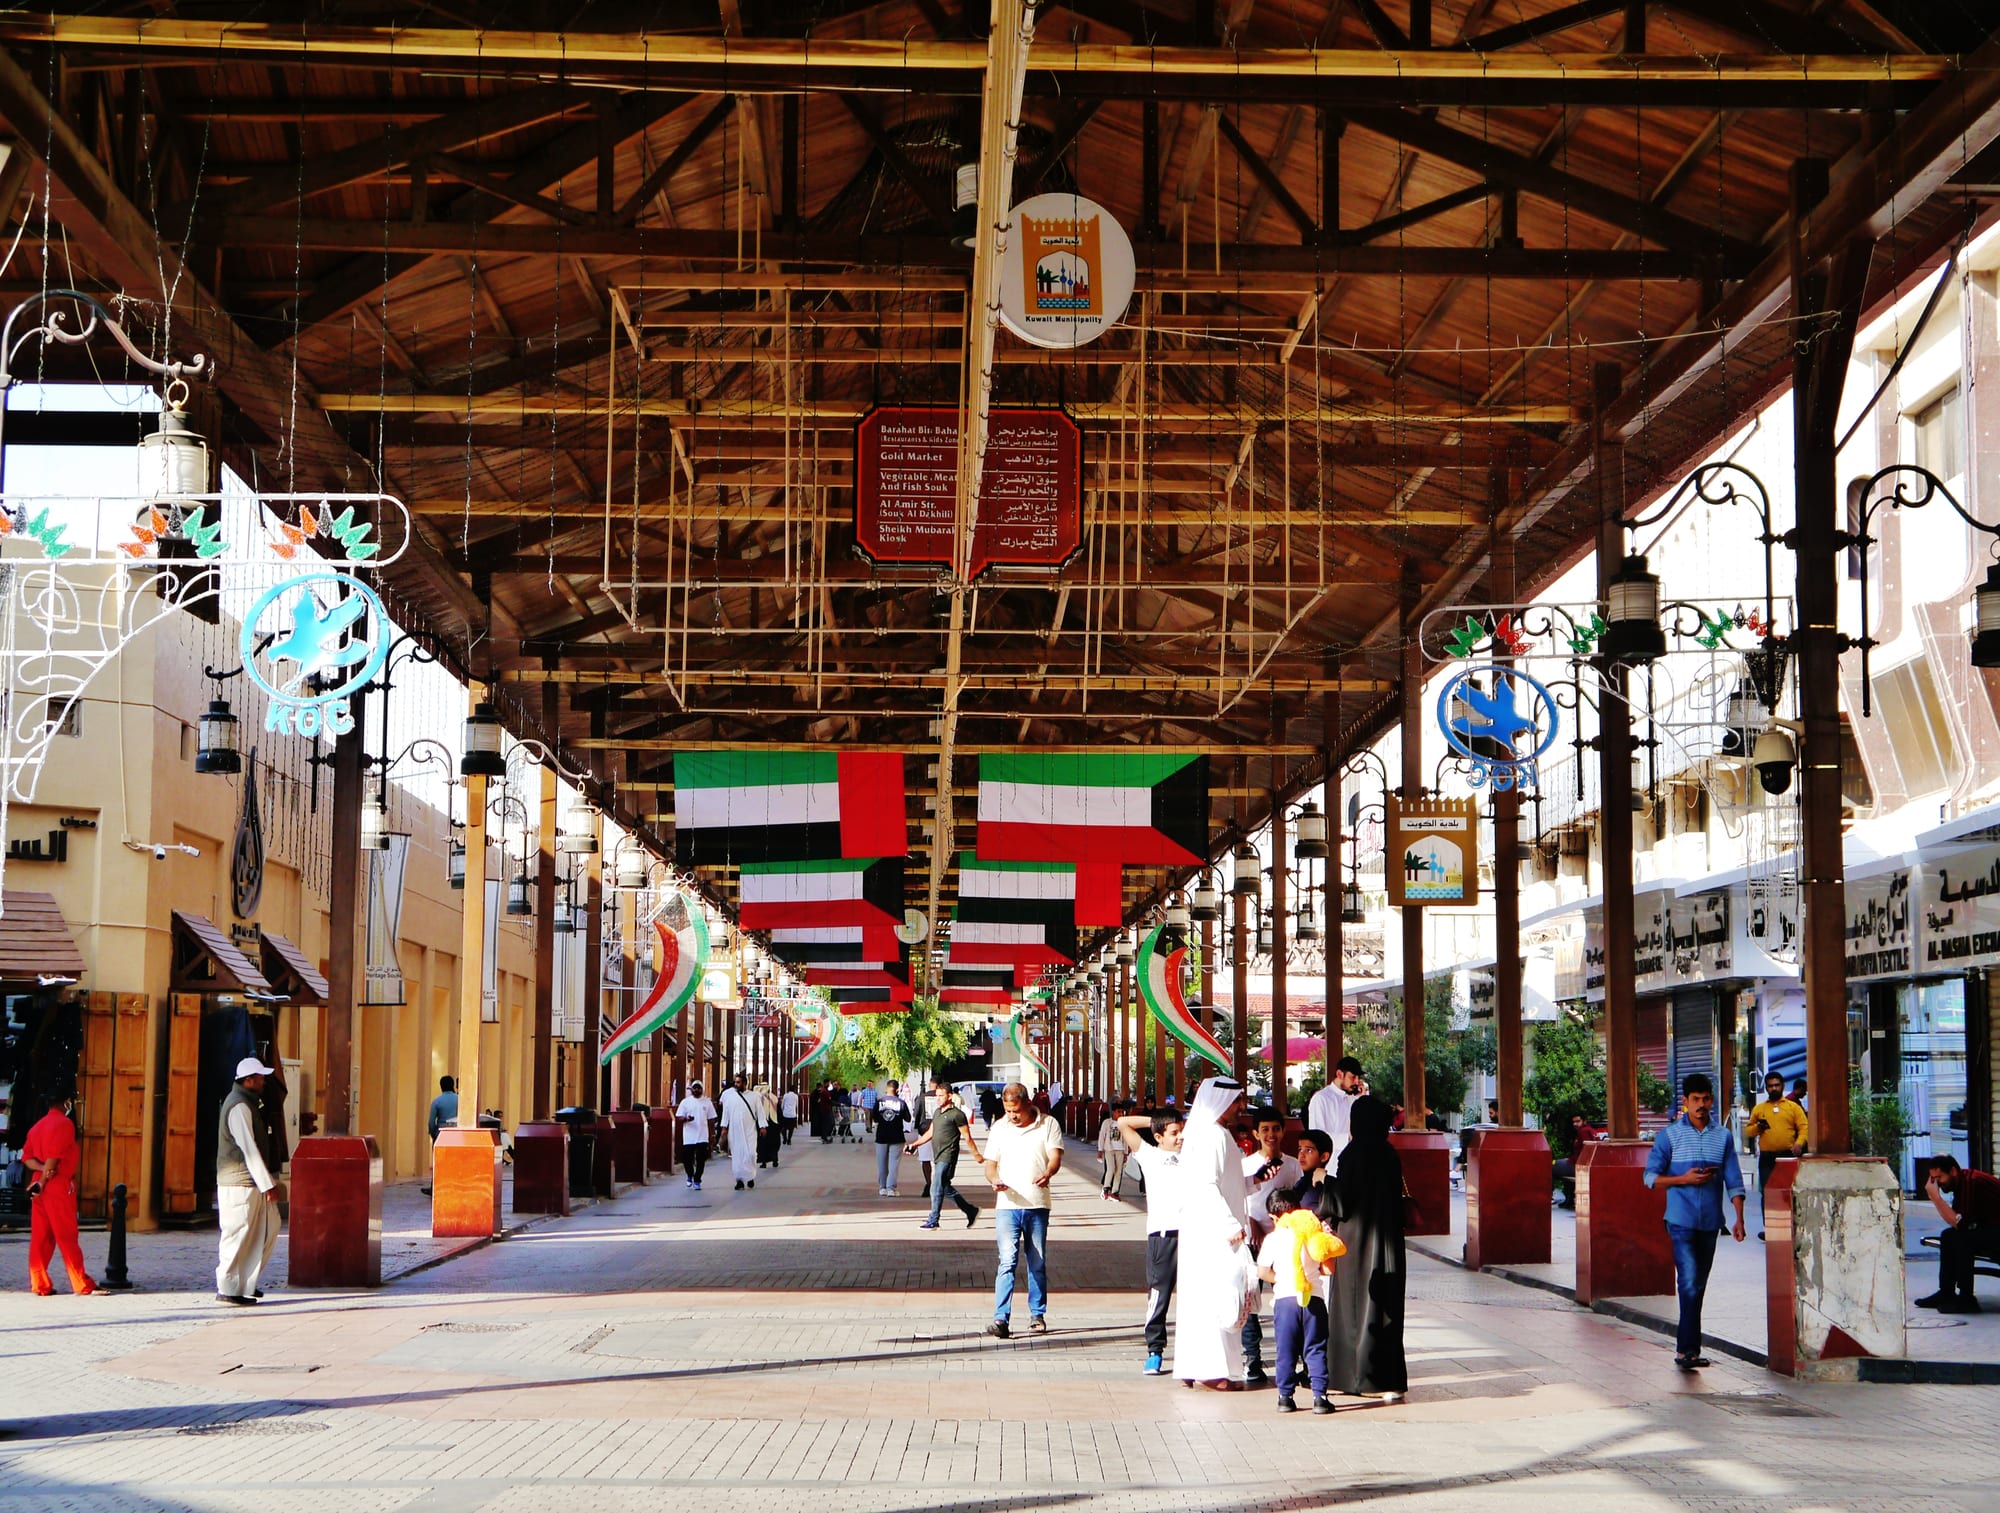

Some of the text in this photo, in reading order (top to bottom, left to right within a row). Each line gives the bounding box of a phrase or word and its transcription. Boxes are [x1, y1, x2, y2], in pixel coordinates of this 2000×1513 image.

[1025, 315, 1103, 324] Kuwait Municipality
[881, 424, 958, 435] Barahat Bin Baha
[1016, 428, 1030, 438] بن
[1029, 426, 1058, 438] براحة
[880, 451, 943, 461] Gold Market
[1005, 454, 1058, 466] سوق الذهب
[880, 471, 929, 482] Vegetable
[934, 472, 958, 481] Meat
[1036, 474, 1058, 486] سوق
[880, 482, 948, 492] And Fish Souk
[1027, 486, 1058, 497] واللحم
[880, 499, 937, 509] Al Amir Str.
[1005, 500, 1058, 515] شارع الأمير
[907, 509, 917, 518] Al
[880, 524, 912, 533] Sheikh
[1032, 527, 1058, 537] كشك
[880, 533, 907, 543] Kiosk
[999, 536, 1058, 550] الشيخ مبارك
[264, 701, 356, 737] KOC
[1406, 819, 1459, 829] بلدية الكويت
